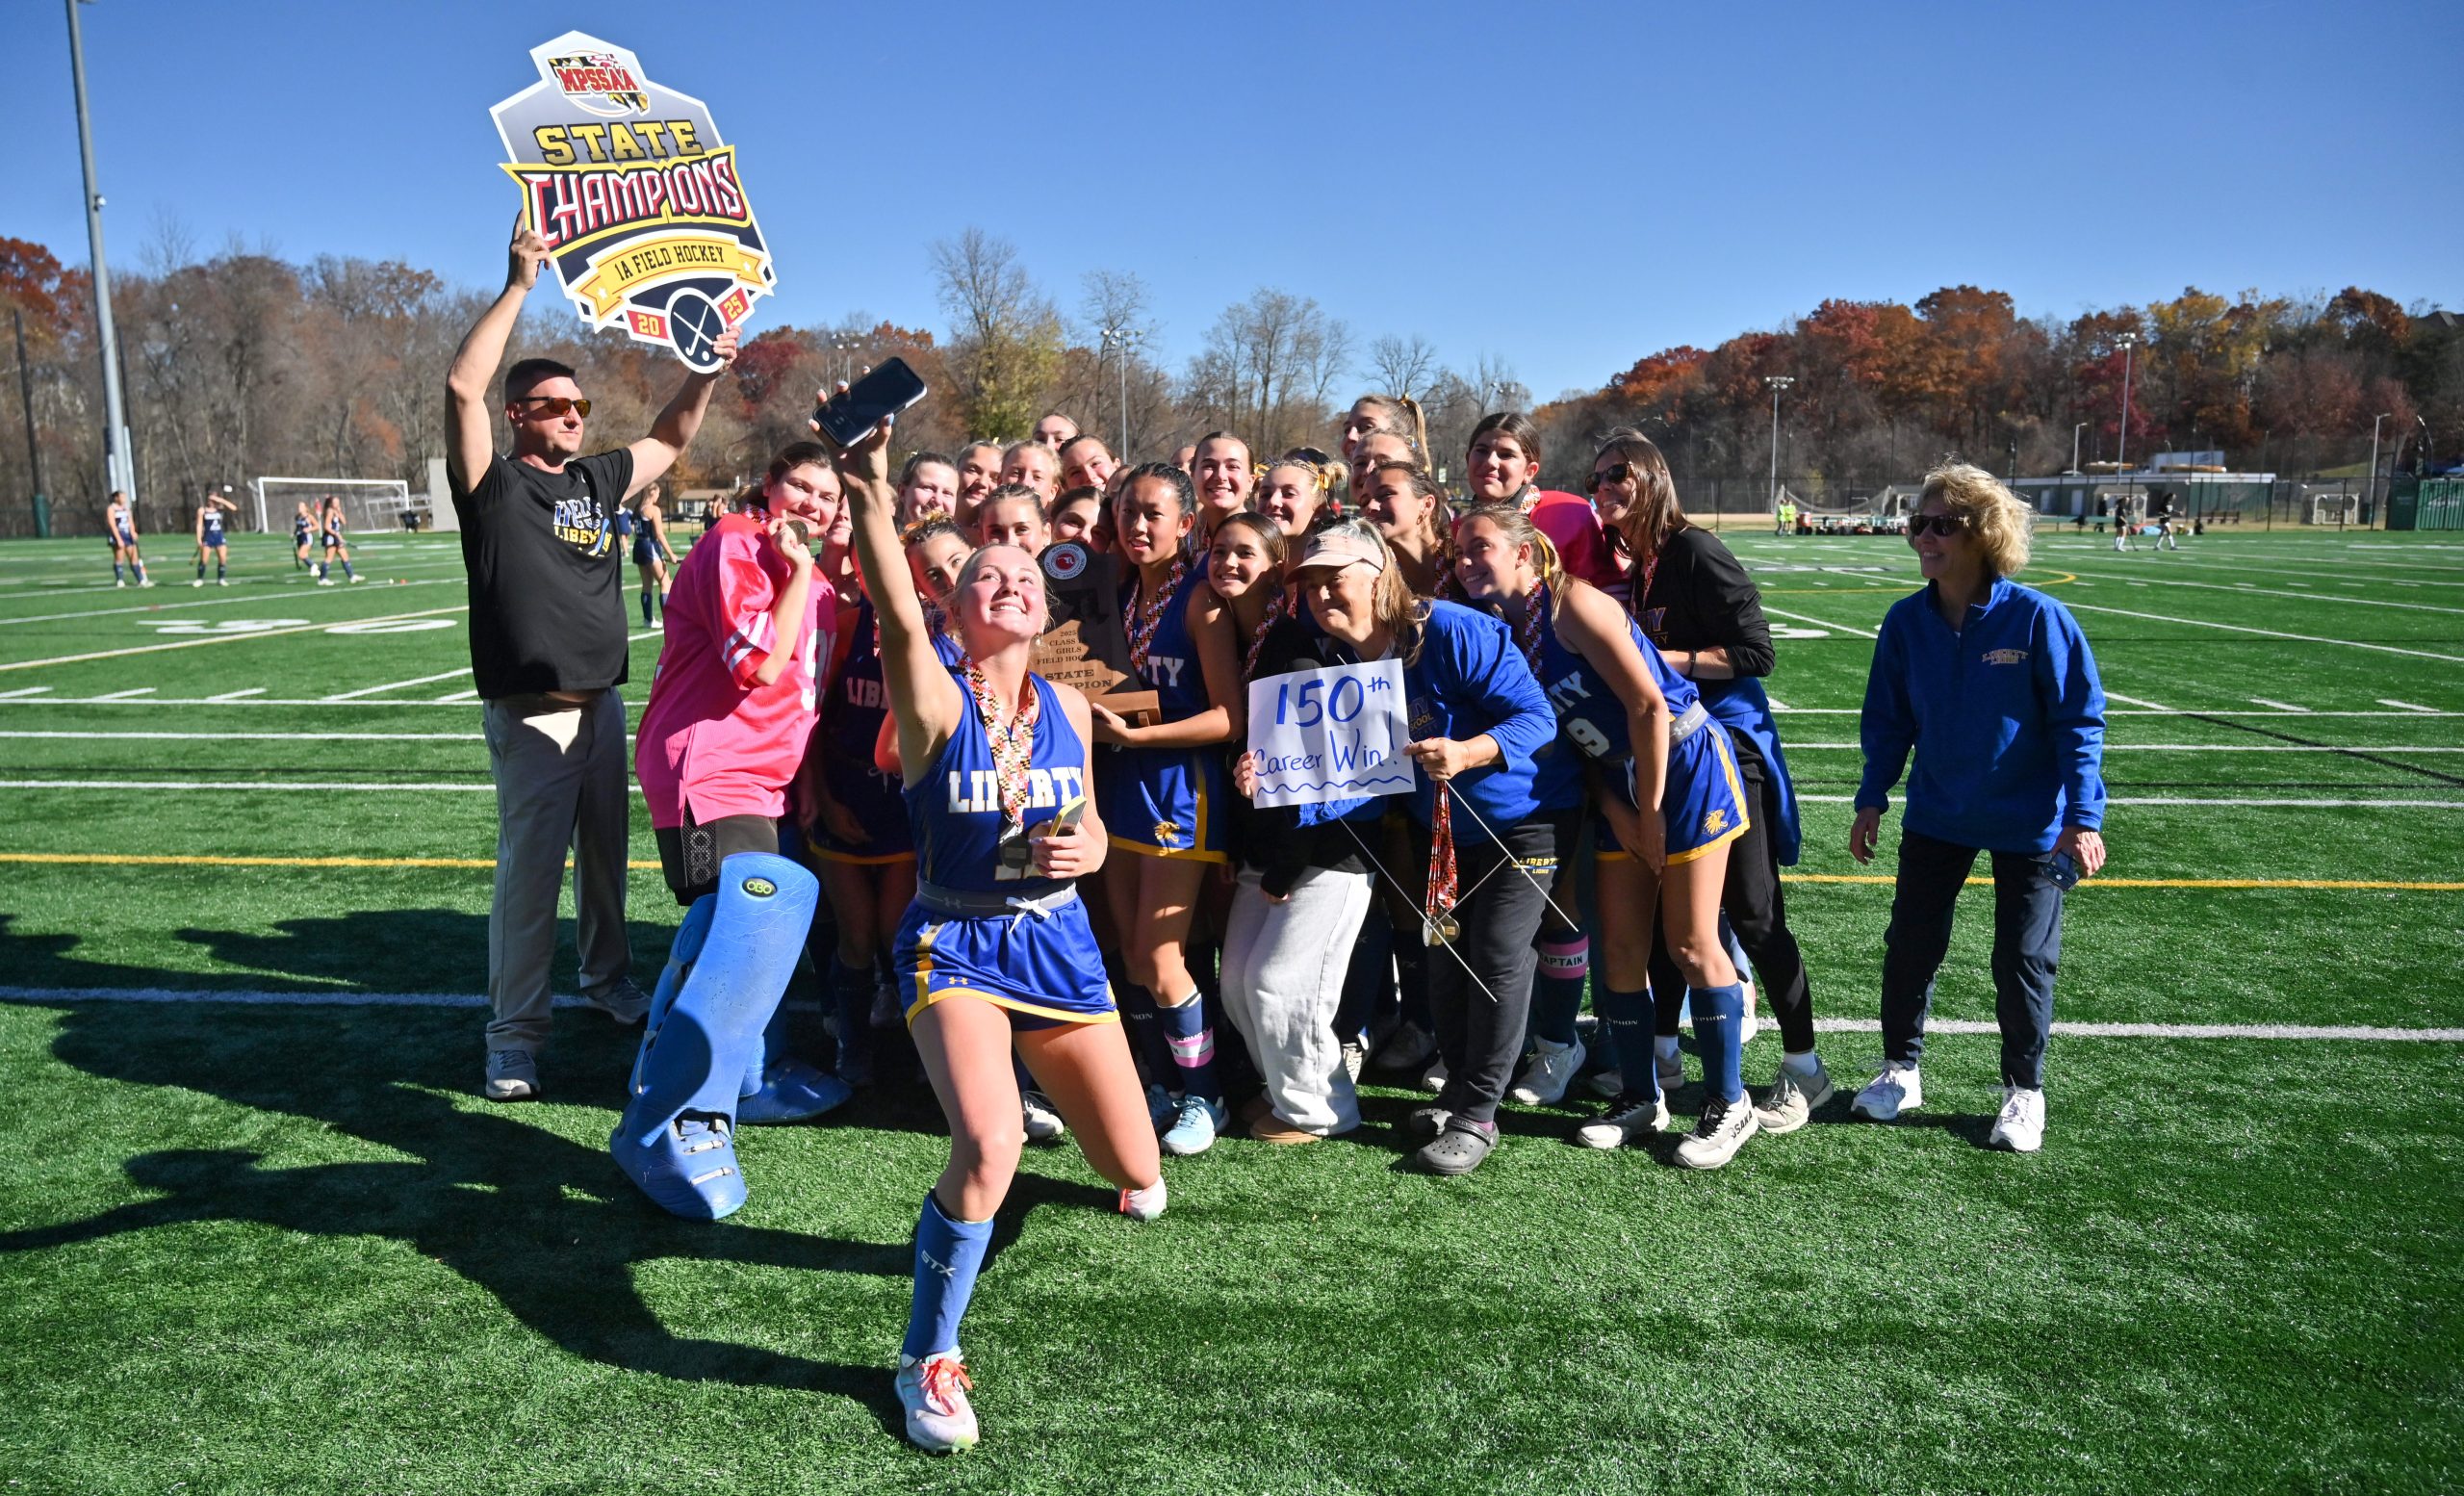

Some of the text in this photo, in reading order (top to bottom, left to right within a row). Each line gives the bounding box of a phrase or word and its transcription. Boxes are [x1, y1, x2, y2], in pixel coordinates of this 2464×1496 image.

[556, 64, 640, 94] MPSSAA
[533, 119, 706, 166] STATE
[520, 155, 747, 248] CHAMPIONS
[614, 245, 726, 281] 1A FIELD HOCKEY
[637, 296, 746, 337] 20 25
[1051, 544, 1080, 554] MARYLAND
[1049, 638, 1076, 647] CLASS
[1056, 646, 1082, 655] GIRLS
[1037, 657, 1064, 665] FIELD
[1044, 669, 1094, 681] STATE
[1275, 675, 1391, 728] 150th
[1253, 710, 1399, 777] Career Win!
[746, 881, 773, 895] OBO
[920, 1249, 957, 1278] STX
